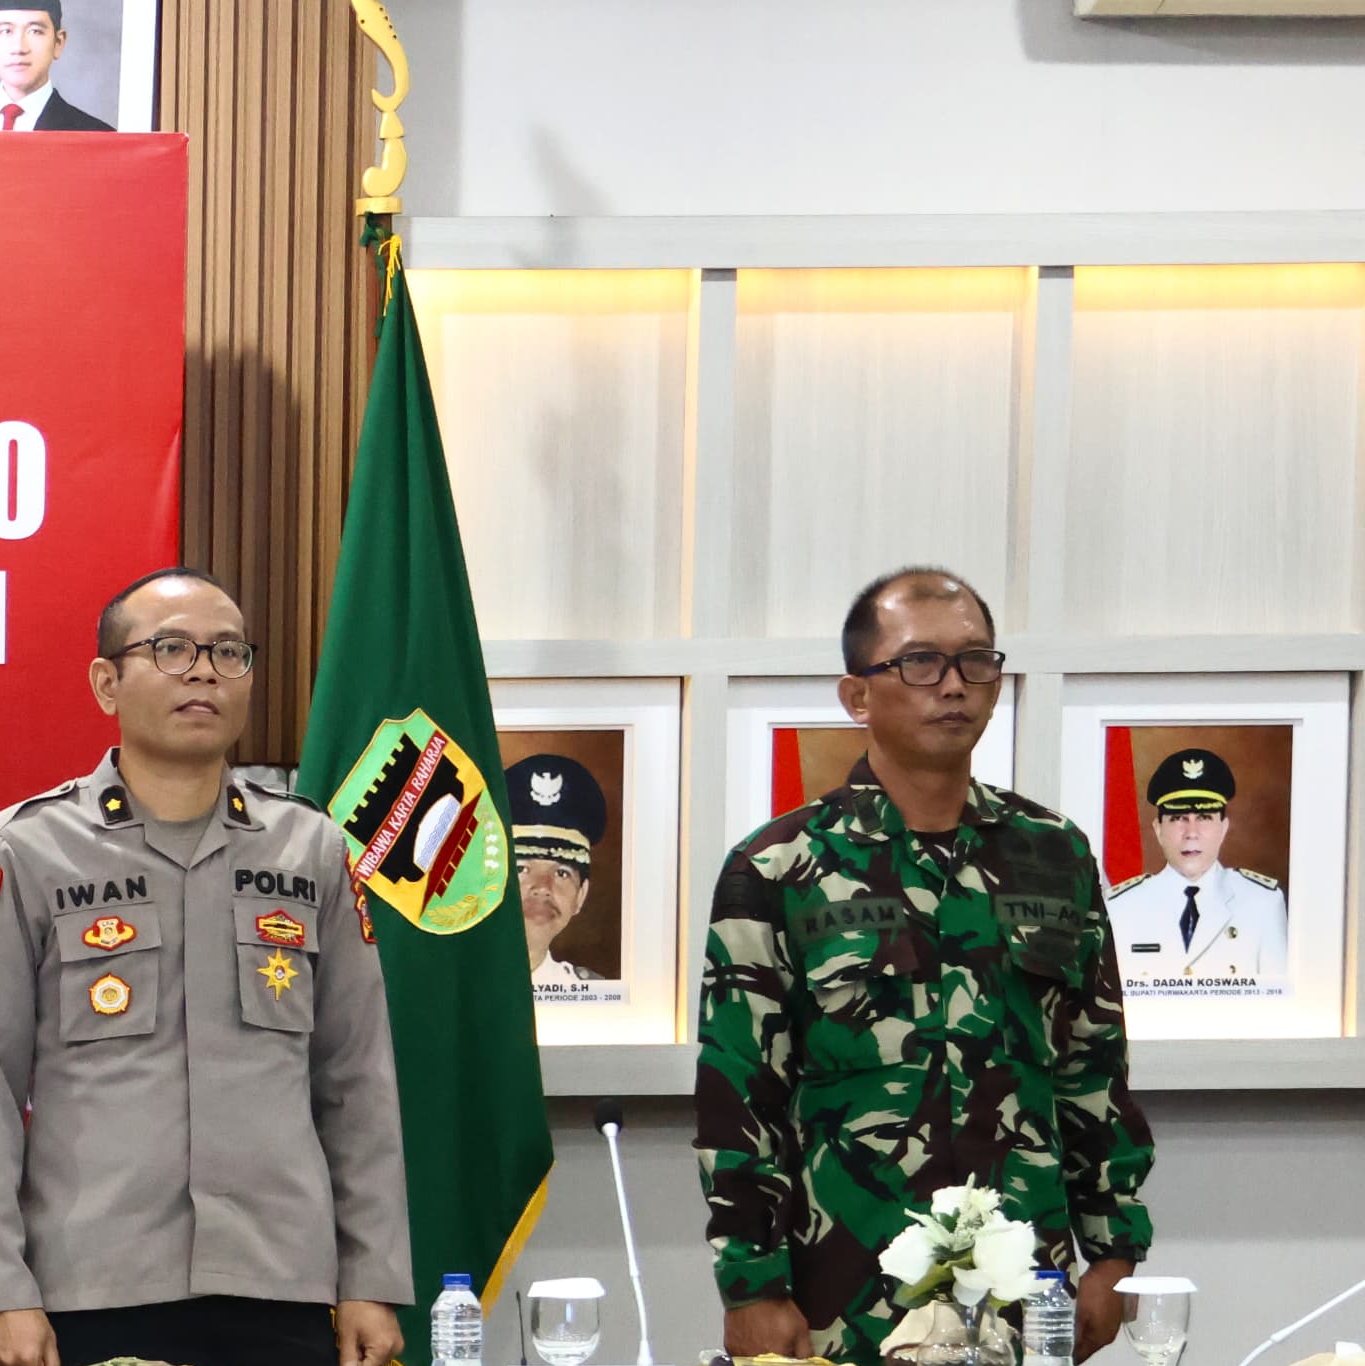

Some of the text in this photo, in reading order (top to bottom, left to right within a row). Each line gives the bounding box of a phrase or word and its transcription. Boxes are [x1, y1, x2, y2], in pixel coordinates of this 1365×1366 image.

[356, 735, 446, 878] WIBAWA KARTA RAHARJA
[56, 875, 147, 909] IWAN
[235, 869, 316, 902] POLRI
[532, 984, 589, 993] LYADI, S.H
[1126, 978, 1256, 988] Drs. DADAN KOSWARA
